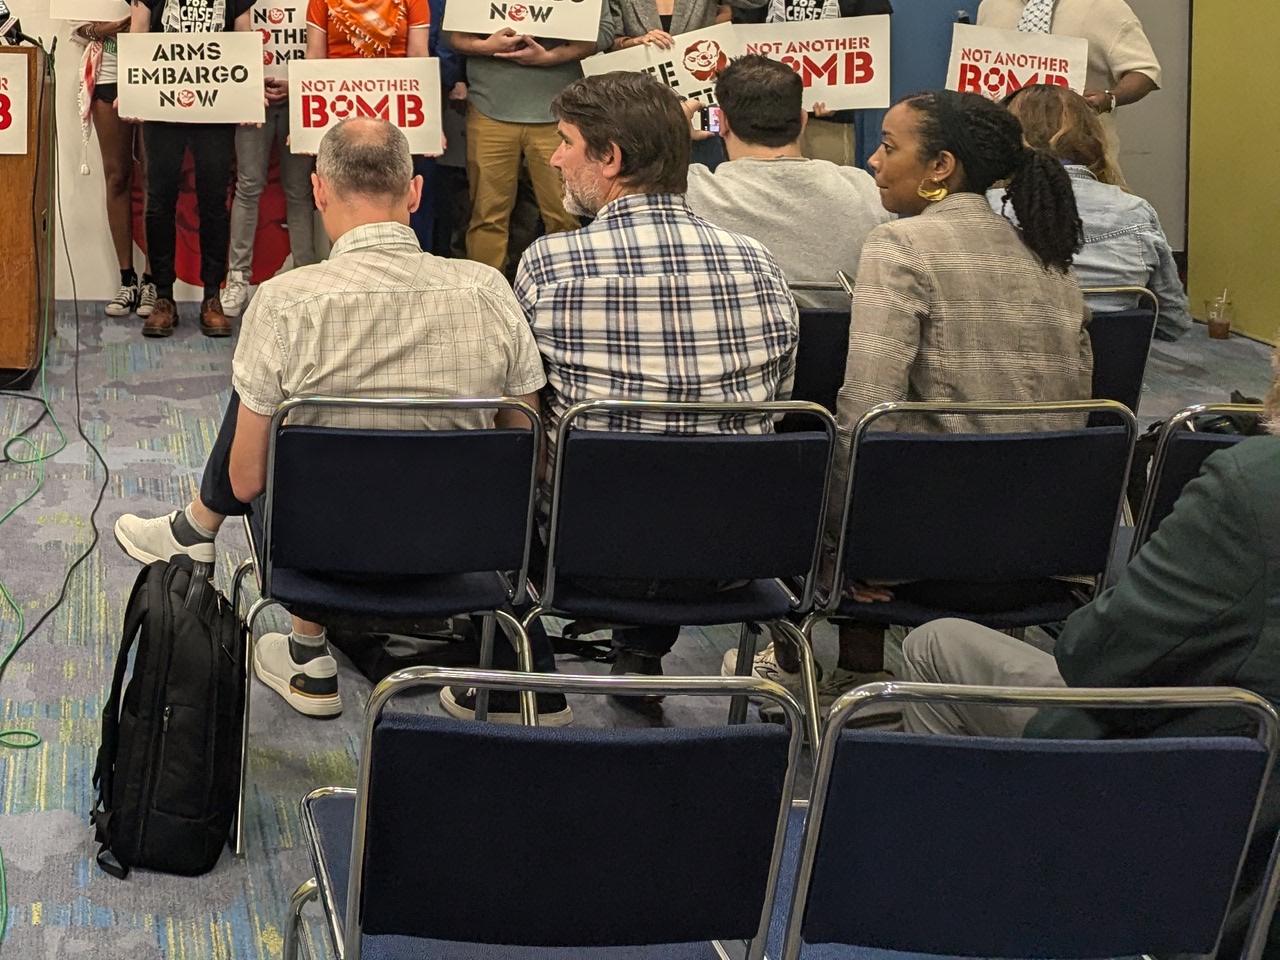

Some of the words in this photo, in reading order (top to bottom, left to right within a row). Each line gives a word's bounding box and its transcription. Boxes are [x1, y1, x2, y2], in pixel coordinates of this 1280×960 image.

[186, 0, 208, 8] FOR
[489, 2, 554, 23] NOW
[180, 7, 213, 22] CEASE
[253, 7, 296, 24] NOT
[786, 6, 822, 21] CEASE
[152, 42, 222, 61] ARMS
[746, 42, 782, 55] NOT
[785, 37, 870, 54] ANOTHER
[961, 48, 992, 63] NOT
[994, 51, 1069, 74] ANOTHER
[128, 64, 249, 85] EMBARGO
[301, 80, 335, 92] NOT
[339, 79, 420, 92] ANOTHER
[159, 89, 219, 107] NOW
[301, 94, 425, 128] BOMB
